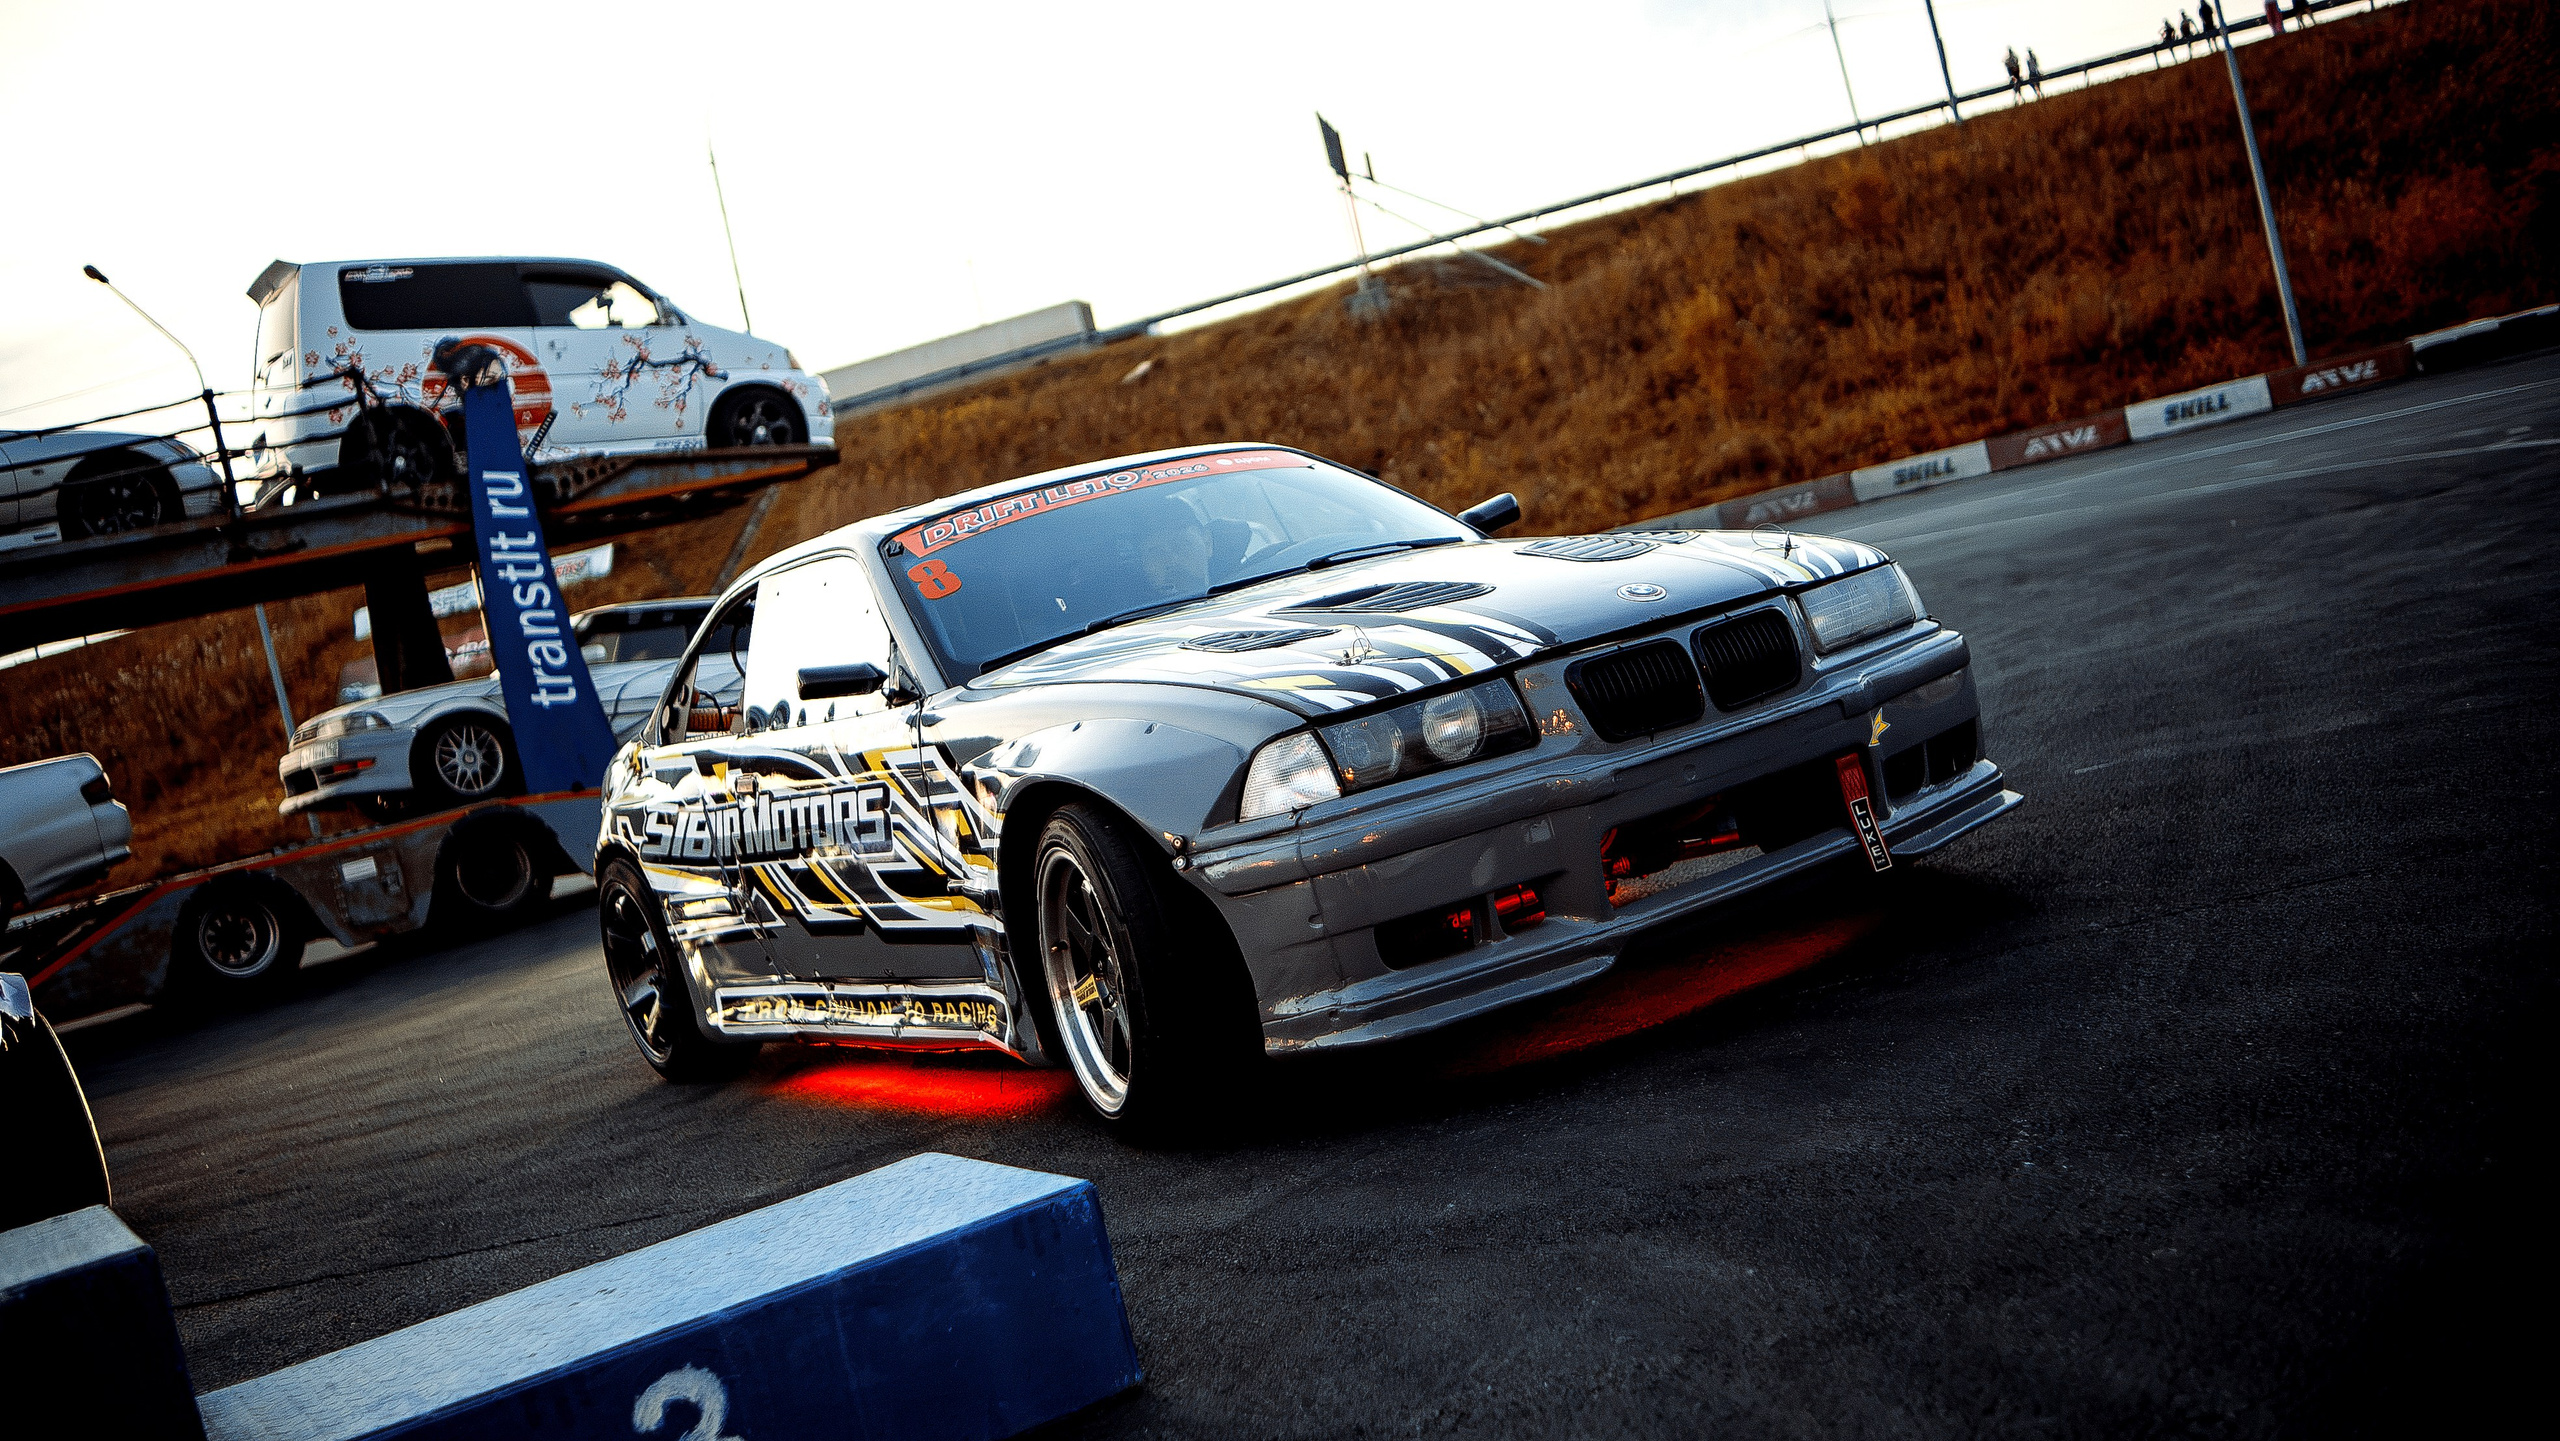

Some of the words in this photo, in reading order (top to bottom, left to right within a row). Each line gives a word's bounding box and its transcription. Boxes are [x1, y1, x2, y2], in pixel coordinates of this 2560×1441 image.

[2164, 393, 2230, 425] SKILL
[1893, 456, 1954, 485] SKILL
[482, 470, 530, 518] ru
[923, 491, 1038, 548] DRIFT
[1047, 470, 1141, 505] LETO
[907, 559, 962, 600] 8
[931, 1001, 997, 1027] RACING
